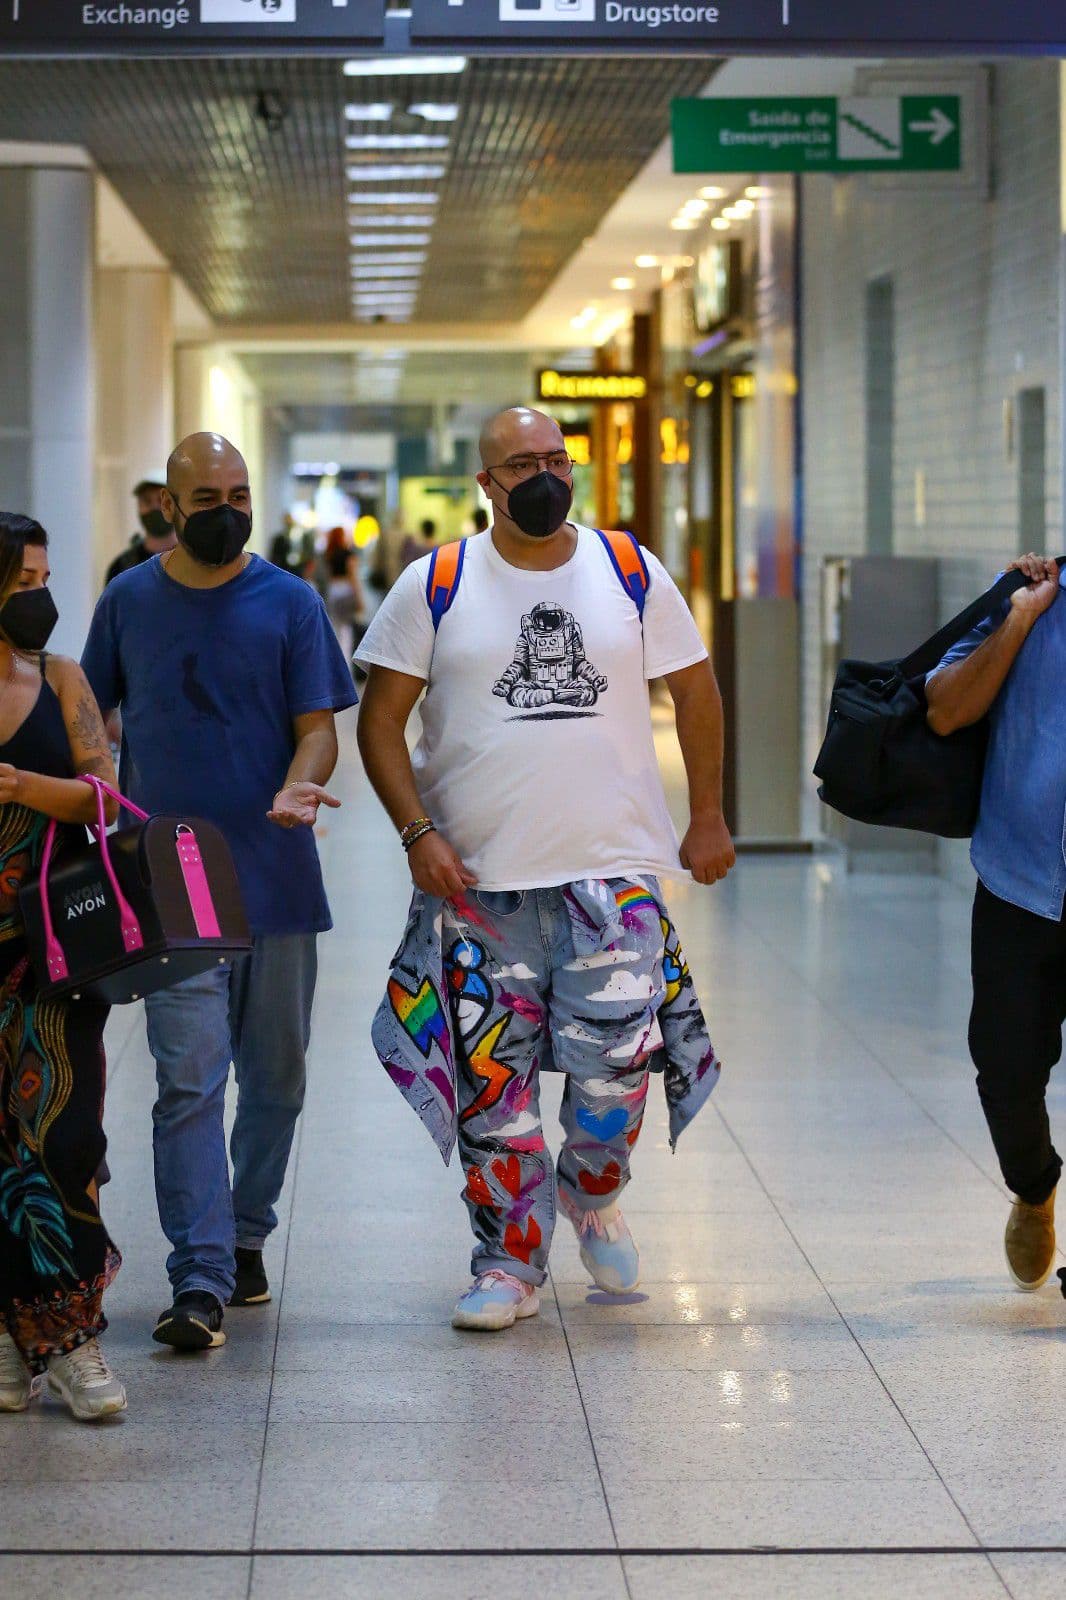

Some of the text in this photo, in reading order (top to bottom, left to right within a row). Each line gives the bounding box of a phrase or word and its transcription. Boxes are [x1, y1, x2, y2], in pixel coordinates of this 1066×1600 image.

[82, 3, 190, 29] Exchange
[605, 2, 719, 28] Drugstore
[67, 894, 106, 920] AVON
